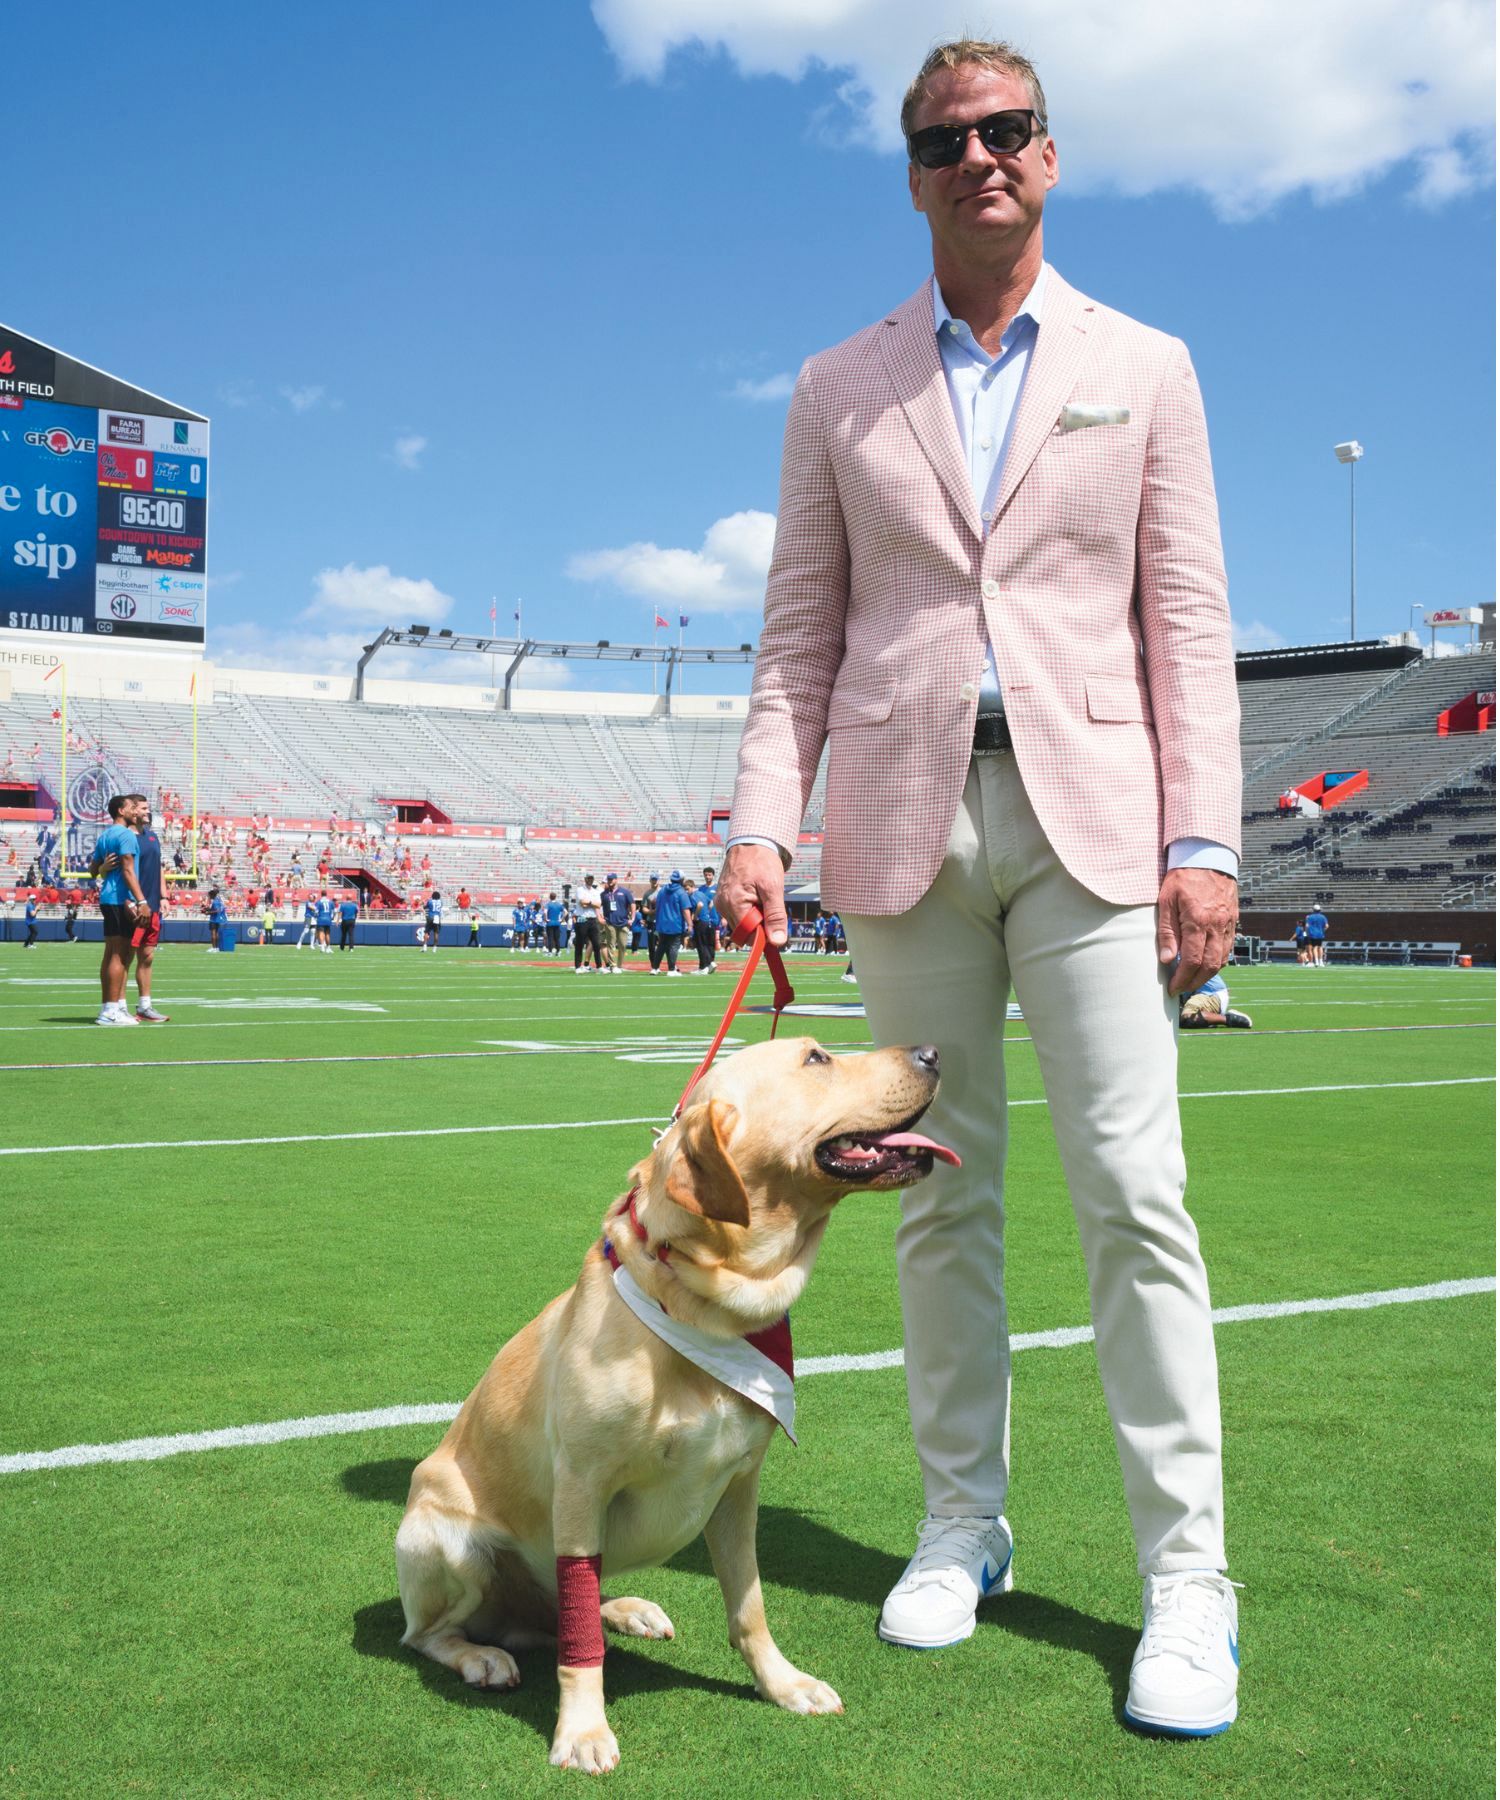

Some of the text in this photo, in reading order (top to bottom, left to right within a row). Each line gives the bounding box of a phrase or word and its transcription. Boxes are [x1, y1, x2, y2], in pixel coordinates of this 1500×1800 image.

[18, 382, 54, 396] FIELD
[111, 425, 141, 435] BUREAU
[119, 419, 141, 429] FARM
[100, 453, 116, 465] Ole
[136, 458, 146, 478] 0
[190, 464, 200, 484] 0
[35, 483, 77, 517] to
[123, 497, 184, 528] 95:00
[98, 528, 204, 549] COUNTDOWN TO KICKOFF
[13, 532, 76, 579] sip
[117, 545, 136, 555] GAME
[112, 553, 142, 564] SPONSOR
[98, 579, 149, 590] Higginbotham
[179, 580, 203, 590] spire
[111, 595, 135, 618] SIP
[164, 607, 193, 617] SONIC
[9, 611, 84, 633] STADIUM
[21, 653, 59, 667] FIELD
